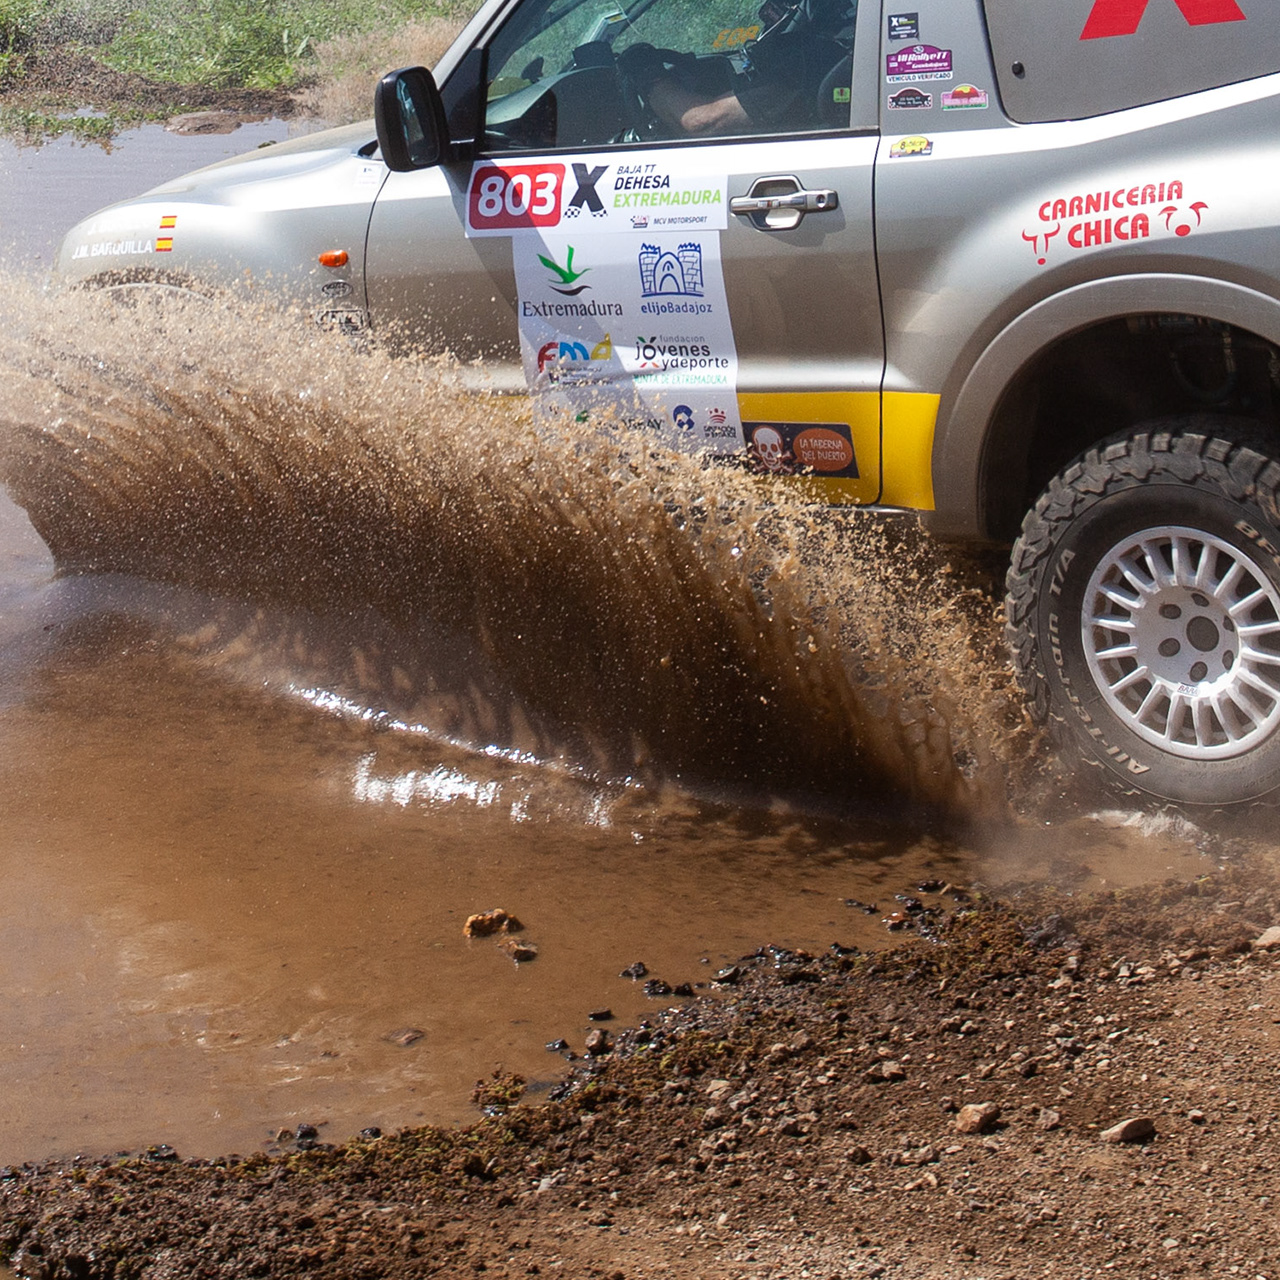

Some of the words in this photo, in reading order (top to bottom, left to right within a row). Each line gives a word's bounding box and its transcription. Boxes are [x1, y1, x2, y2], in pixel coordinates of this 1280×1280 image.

[617, 165, 642, 175] BAJA
[645, 164, 657, 173] TT
[613, 174, 671, 191] DEHESA
[477, 172, 558, 217] 803
[613, 189, 722, 209] EXTREMADURA
[1038, 179, 1183, 221] CARNICERIA
[667, 215, 708, 224] MOTORSPORT
[1067, 212, 1150, 248] CHICA
[90, 239, 152, 257] BARQUILLA
[522, 300, 623, 317] Extremadura
[641, 301, 713, 315] elijoBadajoz
[662, 356, 729, 371] ydeporte
[660, 373, 670, 384] DE
[671, 373, 728, 385] EXTREMADURA
[799, 438, 809, 448] LA
[809, 437, 843, 450] TABERNA
[801, 449, 815, 461] DEL
[817, 450, 846, 461] PUERTO
[1048, 548, 1077, 598] T/A
